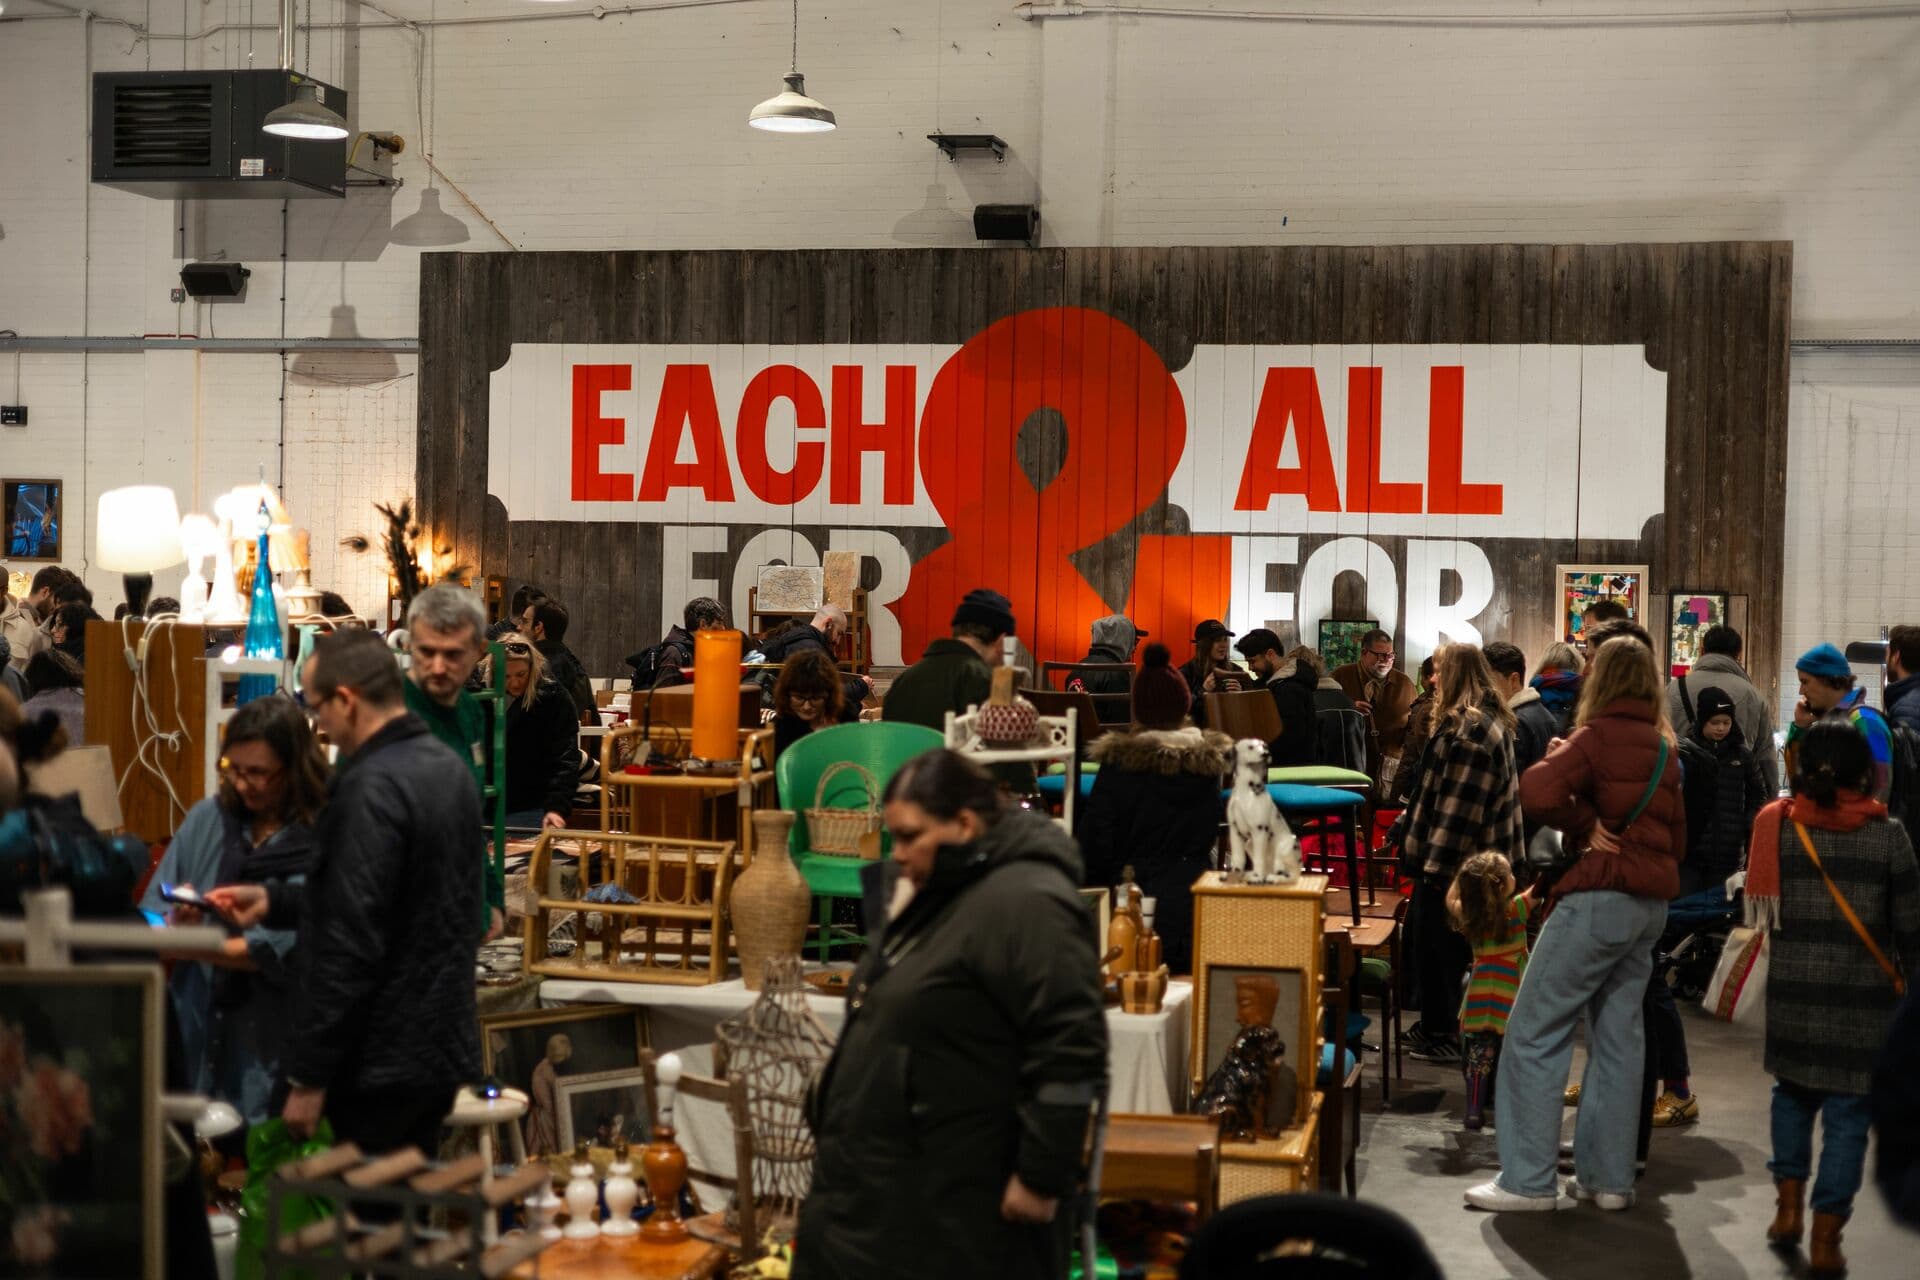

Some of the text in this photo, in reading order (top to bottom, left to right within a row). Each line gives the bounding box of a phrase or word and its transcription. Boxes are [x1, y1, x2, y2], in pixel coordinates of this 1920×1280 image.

[571, 306, 1503, 690] EACH & ALL
[661, 525, 912, 666] FOR
[1229, 535, 1494, 680] FOR
